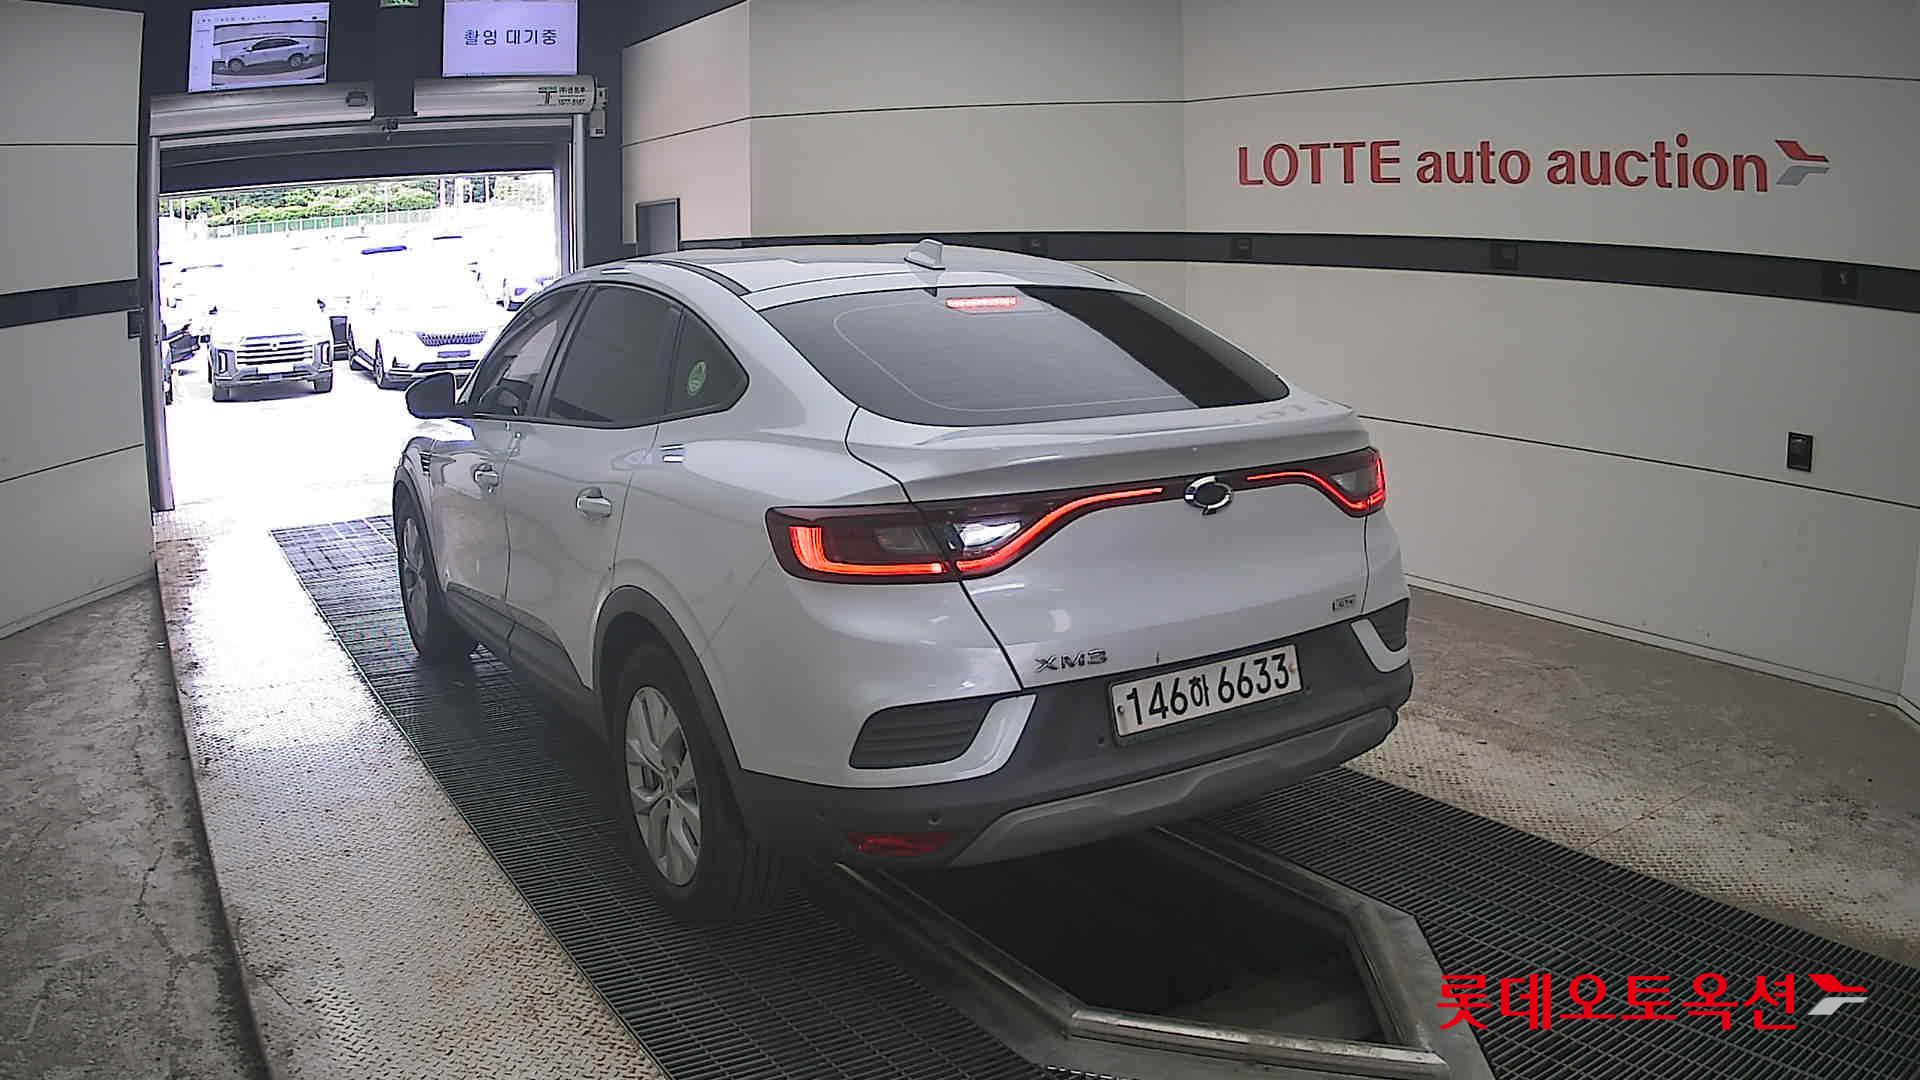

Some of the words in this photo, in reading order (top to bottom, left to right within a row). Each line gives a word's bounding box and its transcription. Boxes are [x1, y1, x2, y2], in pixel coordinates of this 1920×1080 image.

[505, 29, 558, 46] 대기중
[1238, 139, 1401, 187] LOTTE
[1416, 140, 1531, 184] auto
[1546, 132, 1768, 193] auction
[1035, 648, 1107, 672] XM3
[1126, 673, 1210, 726] 146하
[1217, 652, 1290, 704] 6633
